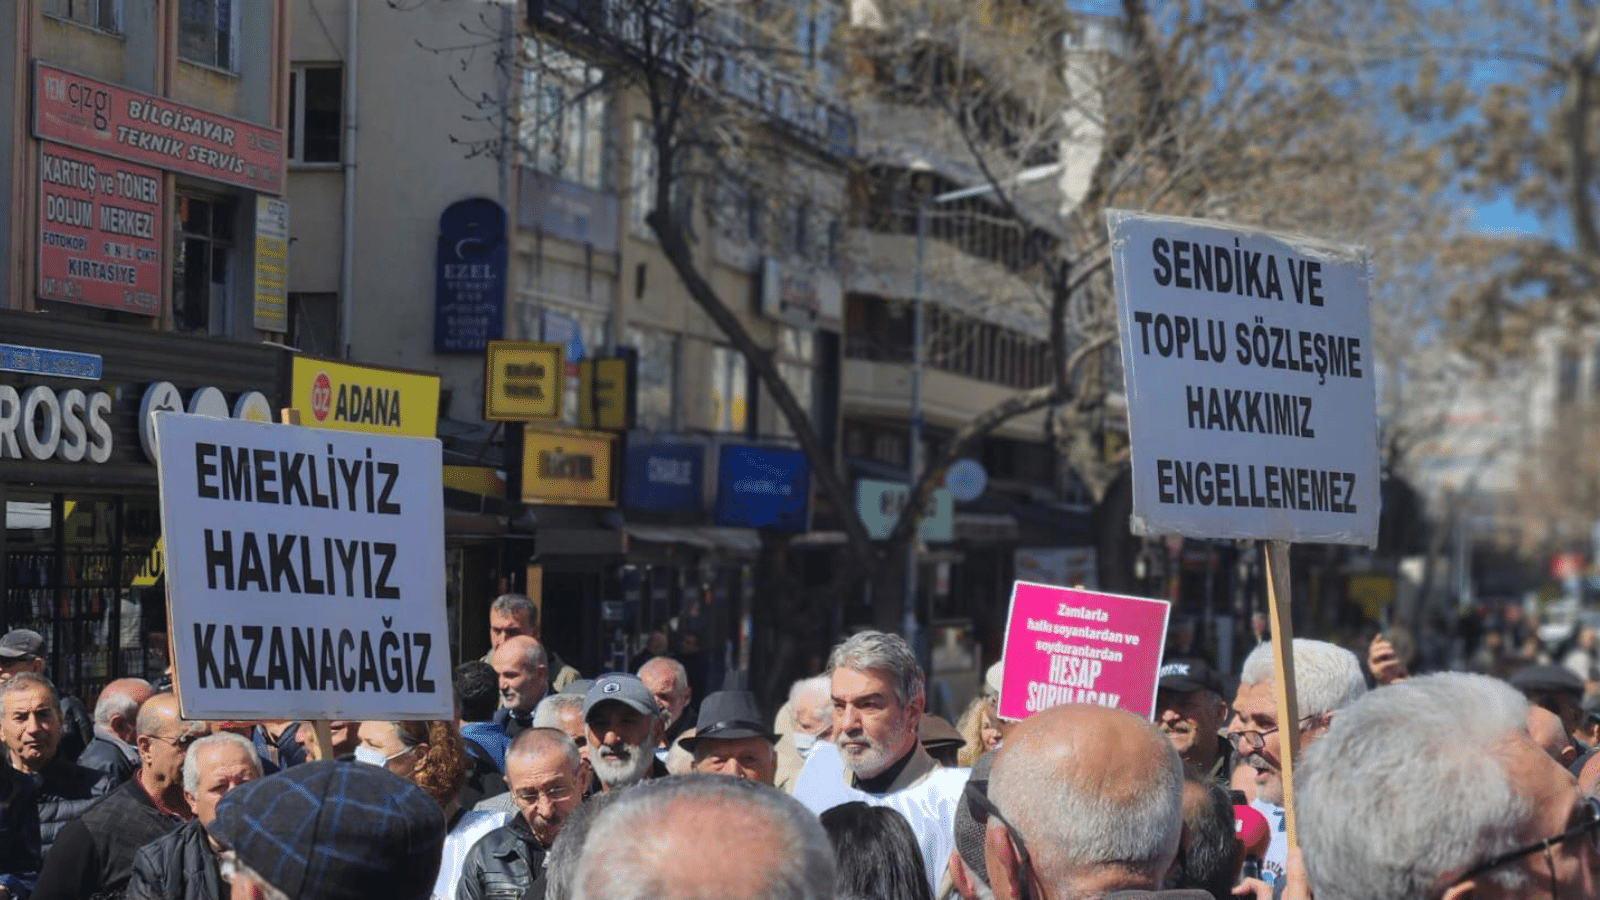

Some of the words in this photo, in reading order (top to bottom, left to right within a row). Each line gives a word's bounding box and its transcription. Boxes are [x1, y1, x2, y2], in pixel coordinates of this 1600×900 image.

[128, 98, 235, 147] BİLGİSAYAR
[116, 125, 184, 159] TEKNİK
[187, 145, 246, 174] SERVİS
[42, 154, 97, 197] KARTUŞ
[100, 173, 115, 195] ve
[117, 171, 157, 204] TONER
[46, 193, 93, 229] DOLUM
[100, 204, 155, 240] MERKEZİ
[68, 258, 136, 285] KIRTASİYE
[444, 264, 497, 279] EZEL
[1152, 236, 1284, 301] SENDİKA
[1287, 257, 1325, 307] VE
[1134, 310, 1227, 363] TOPLU
[1234, 315, 1363, 386] SÖZLEŞME
[335, 383, 402, 428] ADANA
[1186, 385, 1315, 439] HAKKIMIZ
[195, 442, 401, 515] EMEKLİYİZ
[1156, 459, 1358, 514] ENGELLENEMEZ
[203, 528, 400, 600] HAKLIYIZ
[1026, 617, 1053, 632] halkı
[1053, 624, 1123, 644] soyanlardan
[1124, 634, 1140, 646] ve
[1056, 602, 1109, 623] Zamlarla
[193, 615, 436, 694] KAZANACAĞIZ
[1035, 640, 1123, 662] soyduranlardan
[1048, 653, 1103, 690] HESAP
